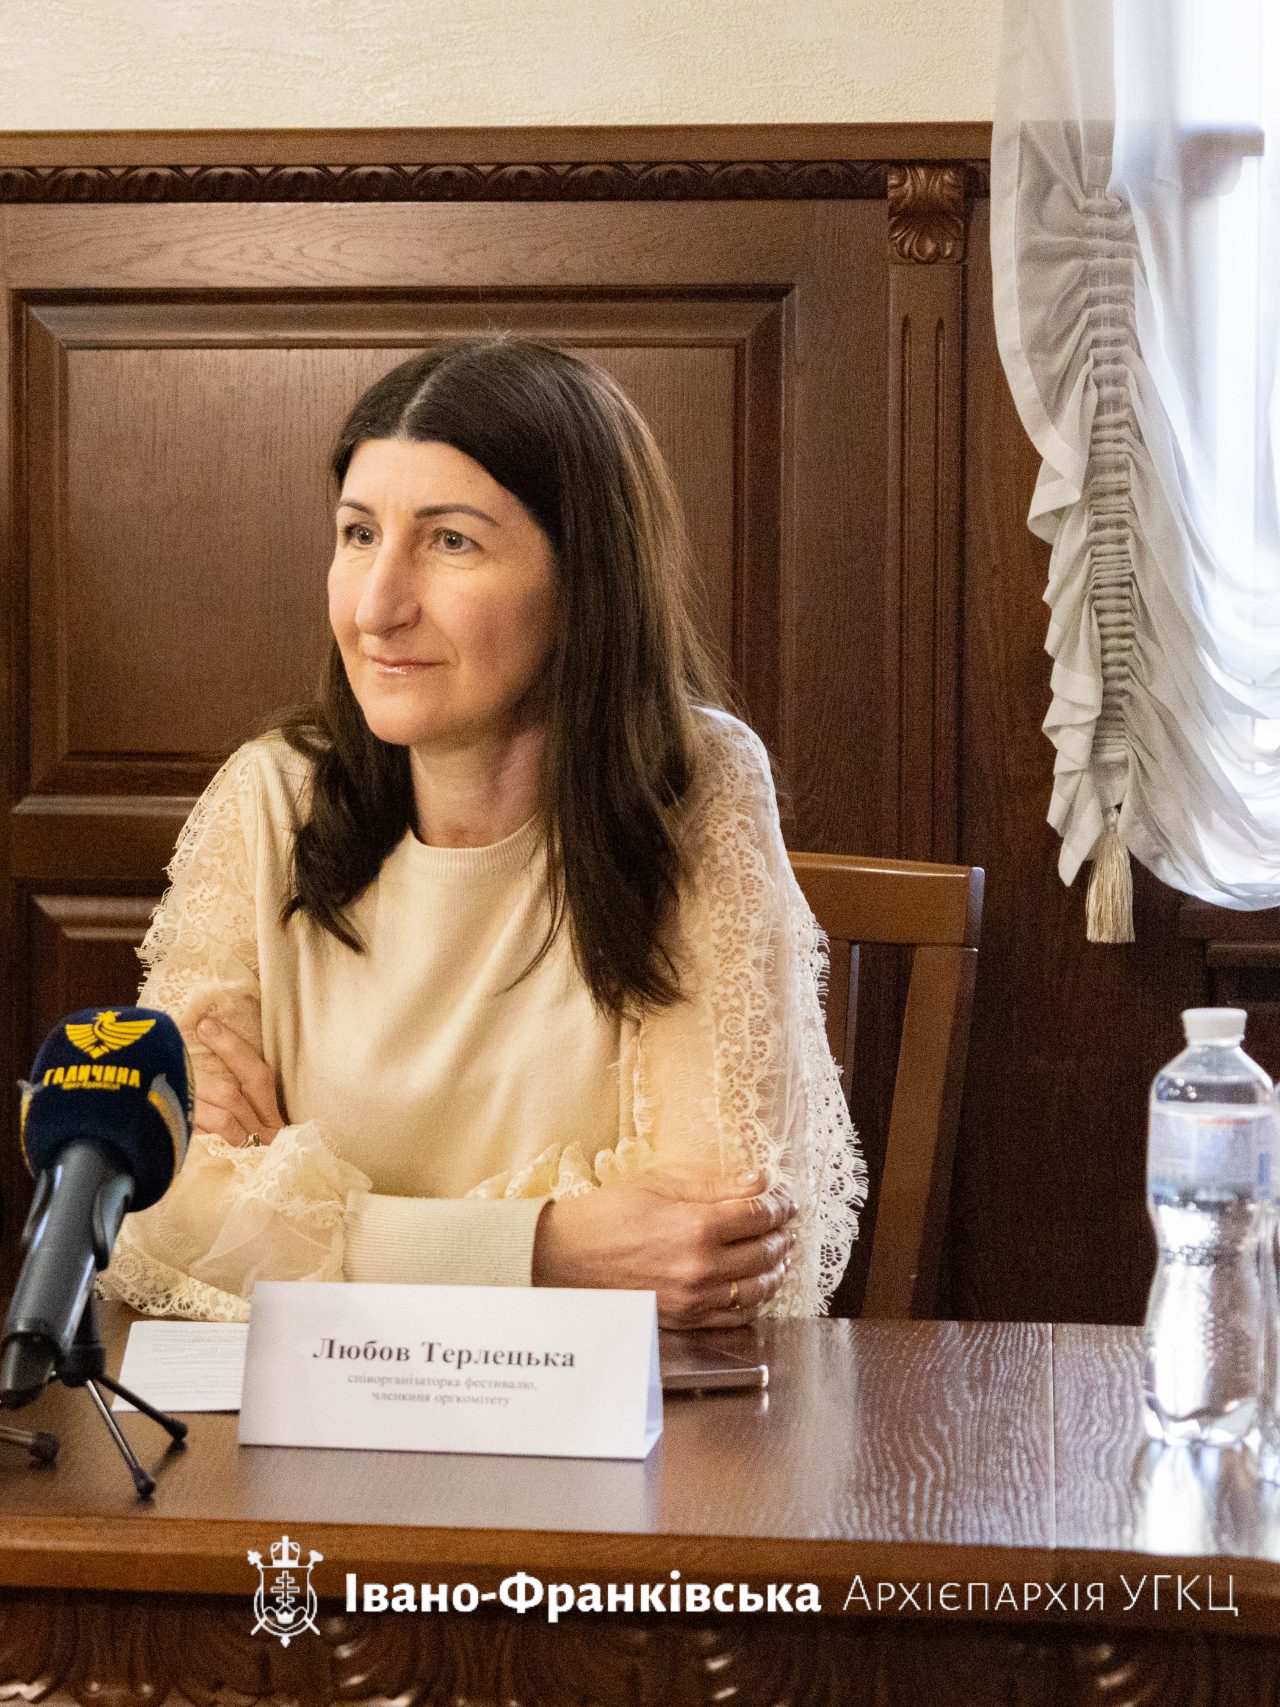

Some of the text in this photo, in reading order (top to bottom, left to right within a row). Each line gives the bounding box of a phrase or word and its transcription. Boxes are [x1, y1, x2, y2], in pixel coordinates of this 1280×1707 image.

[42, 1065, 140, 1088] ГАЛИЧИНА
[312, 1338, 576, 1369] Любов Терлецька
[347, 1372, 462, 1390] співорганізаторка
[434, 1393, 512, 1408] оргкомітету
